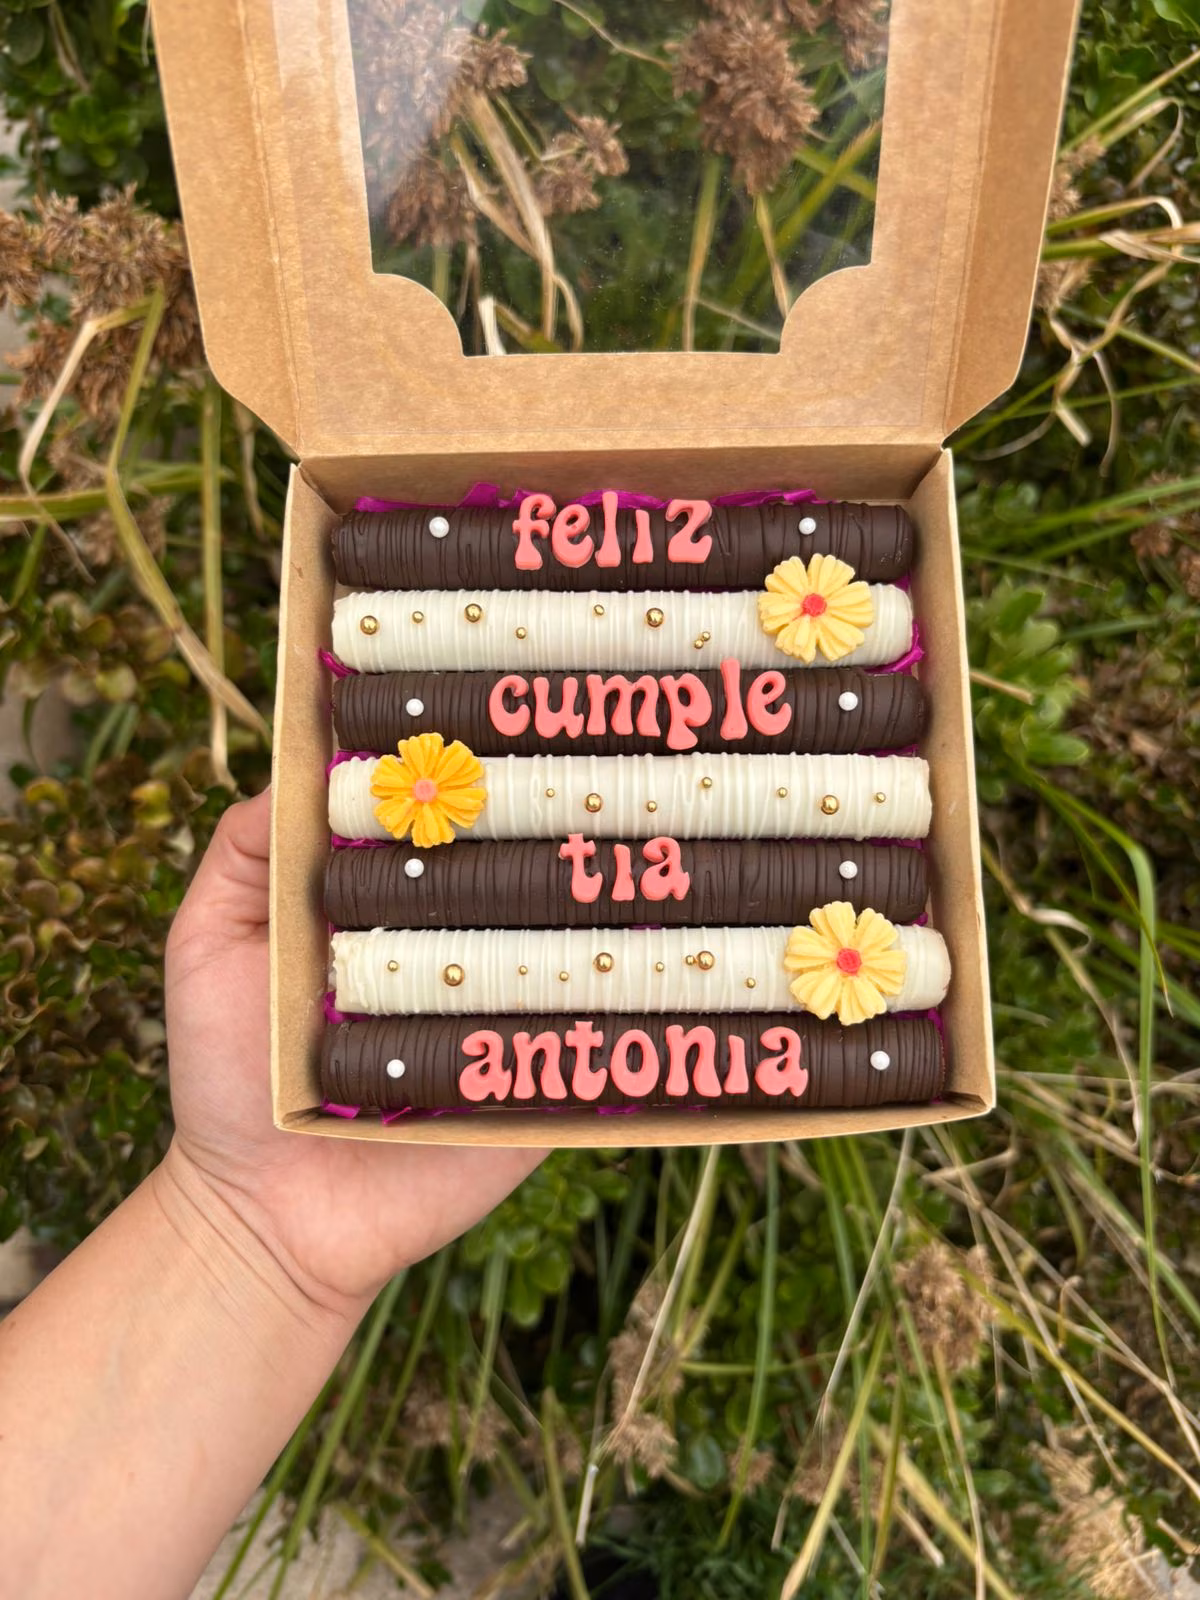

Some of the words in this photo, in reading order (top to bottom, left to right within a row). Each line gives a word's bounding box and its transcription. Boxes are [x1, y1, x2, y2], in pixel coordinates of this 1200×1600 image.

[512, 490, 713, 570] feliz
[489, 659, 793, 750] cumple
[560, 833, 691, 903] tia
[458, 1021, 809, 1102] antonia
